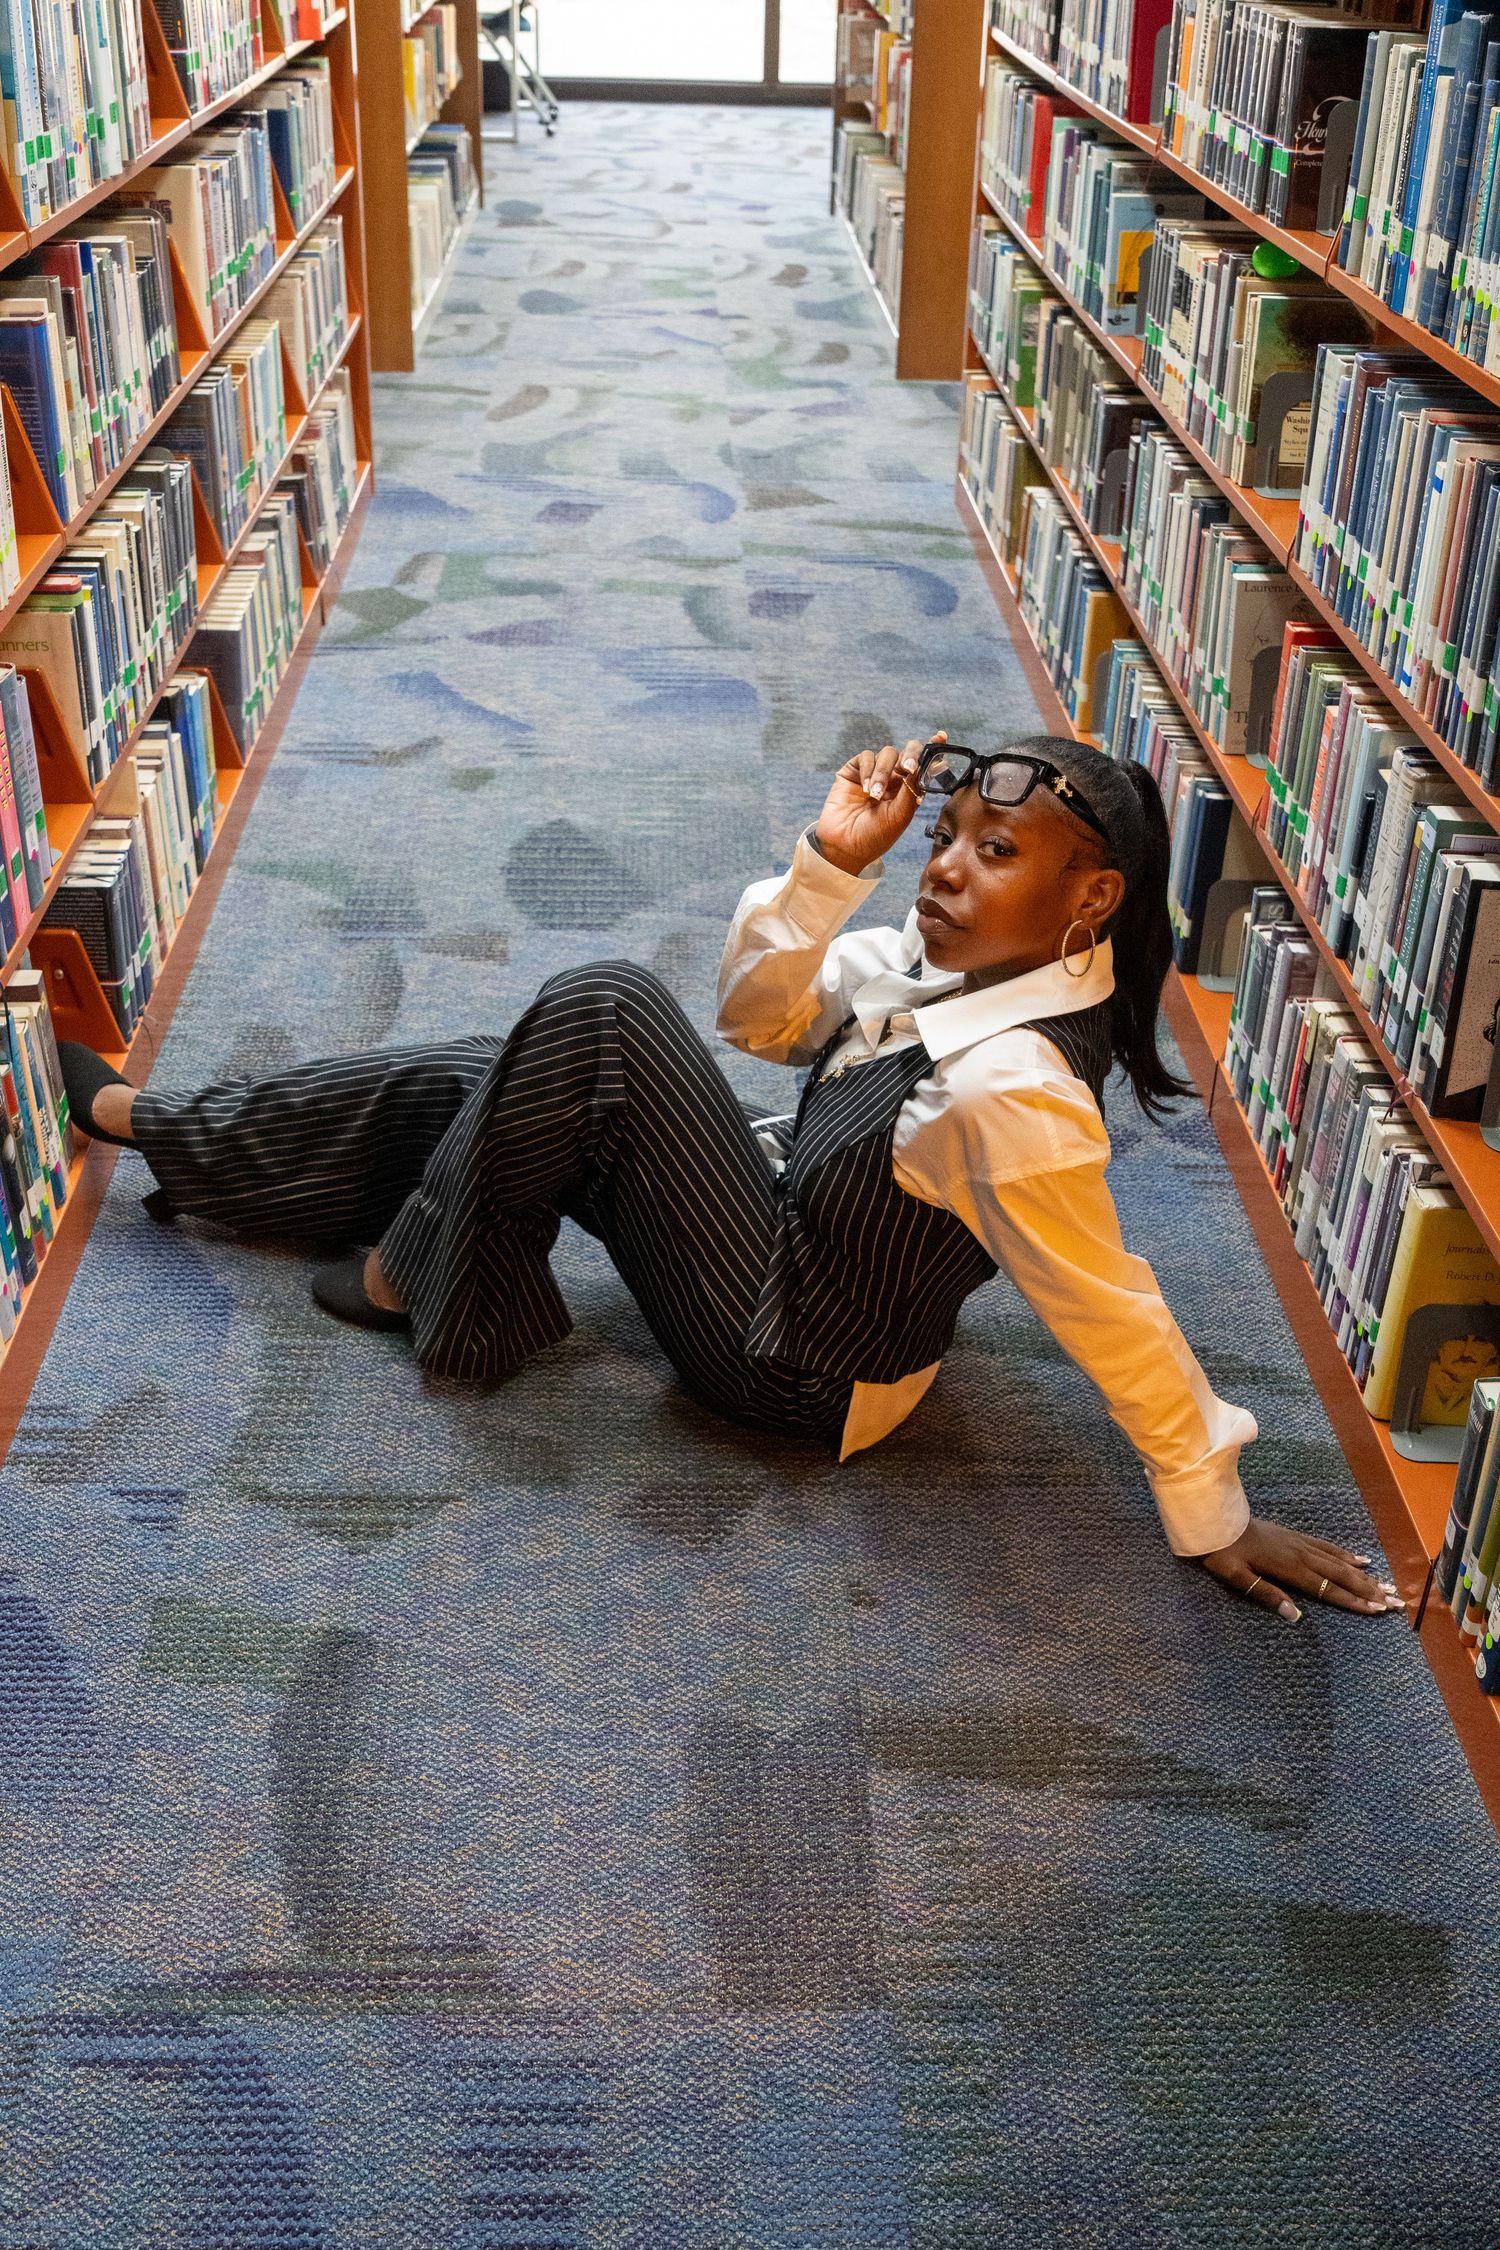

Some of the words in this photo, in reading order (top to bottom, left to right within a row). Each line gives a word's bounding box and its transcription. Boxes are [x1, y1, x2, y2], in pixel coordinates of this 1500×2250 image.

[1449, 71, 1465, 144] MOBY
[1434, 160, 1450, 234] DICK
[1244, 583, 1292, 593] Laurence
[1446, 1270, 1480, 1280] Robert
